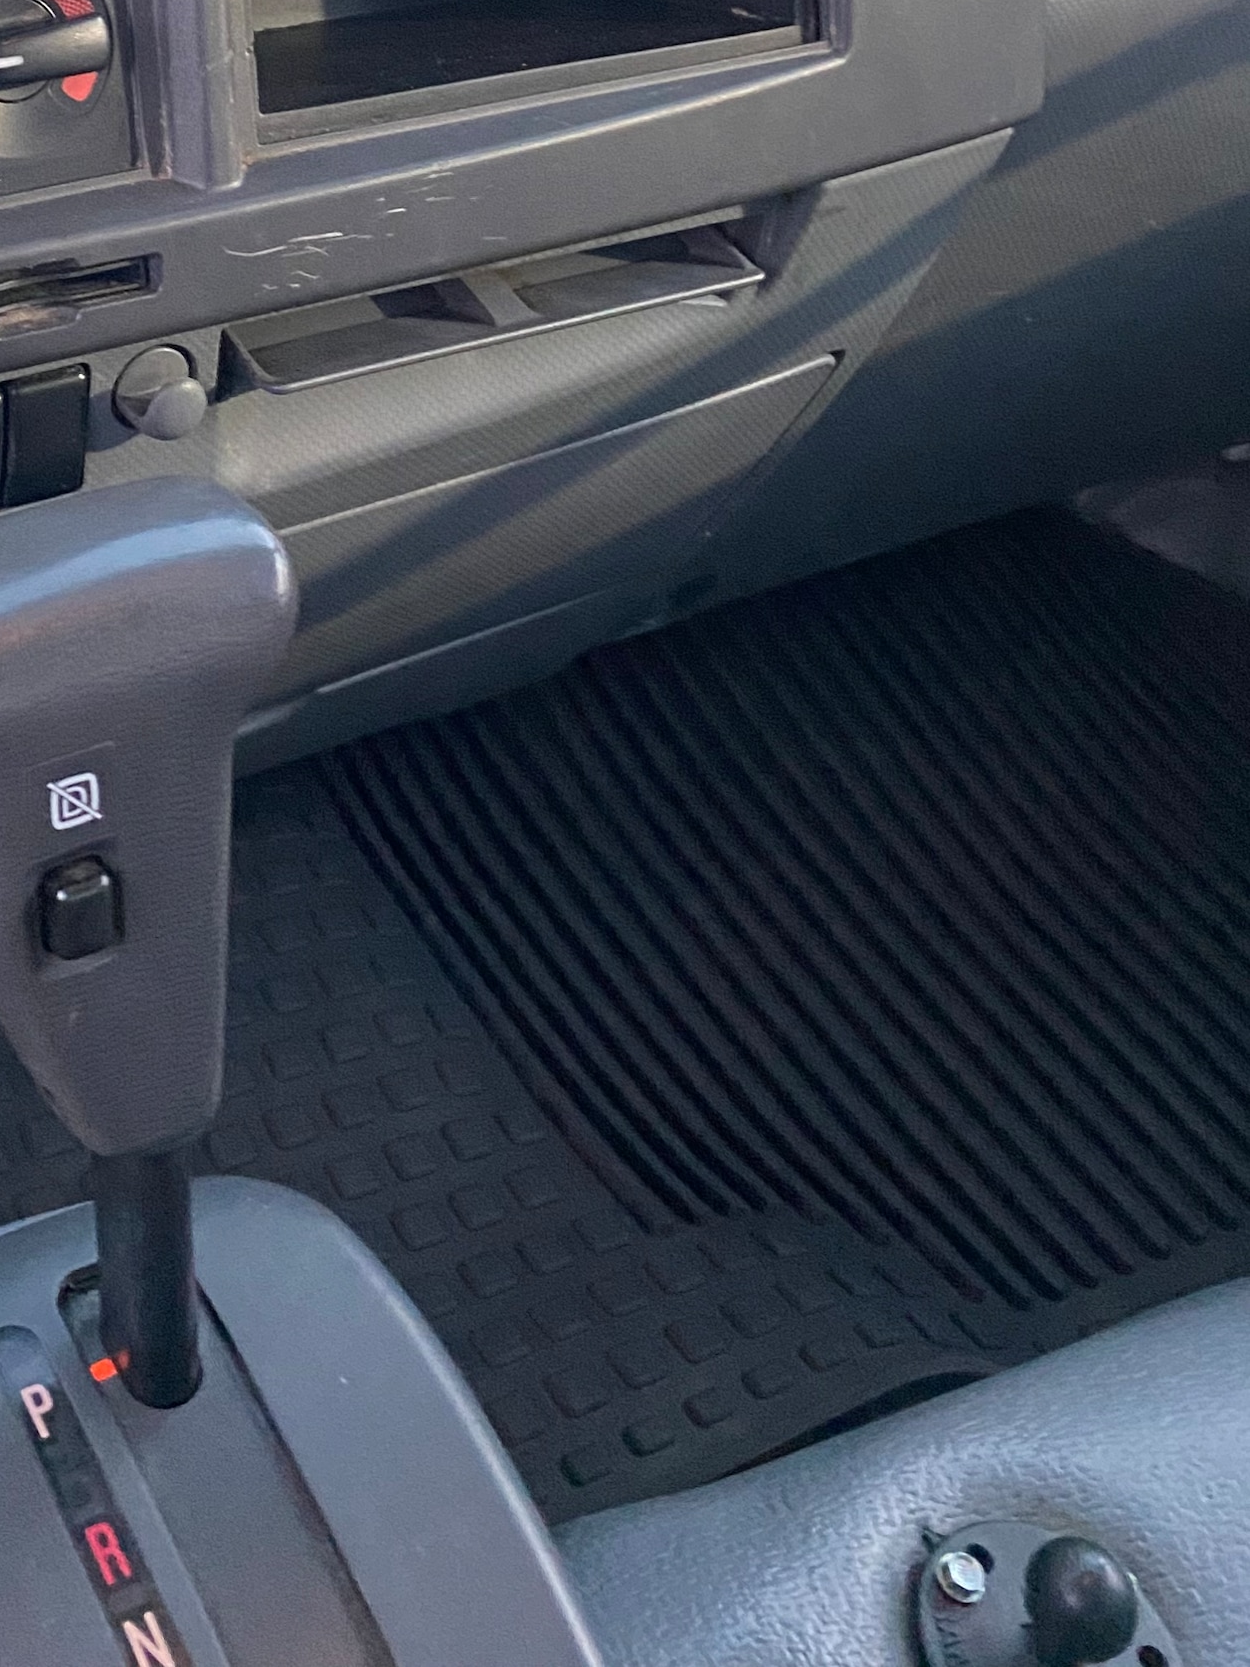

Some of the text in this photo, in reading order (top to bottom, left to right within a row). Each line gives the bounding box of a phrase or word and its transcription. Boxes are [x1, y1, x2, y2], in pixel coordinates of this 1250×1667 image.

[21, 1383, 53, 1438] P
[85, 1521, 132, 1585] R
[124, 1611, 176, 1667] N
